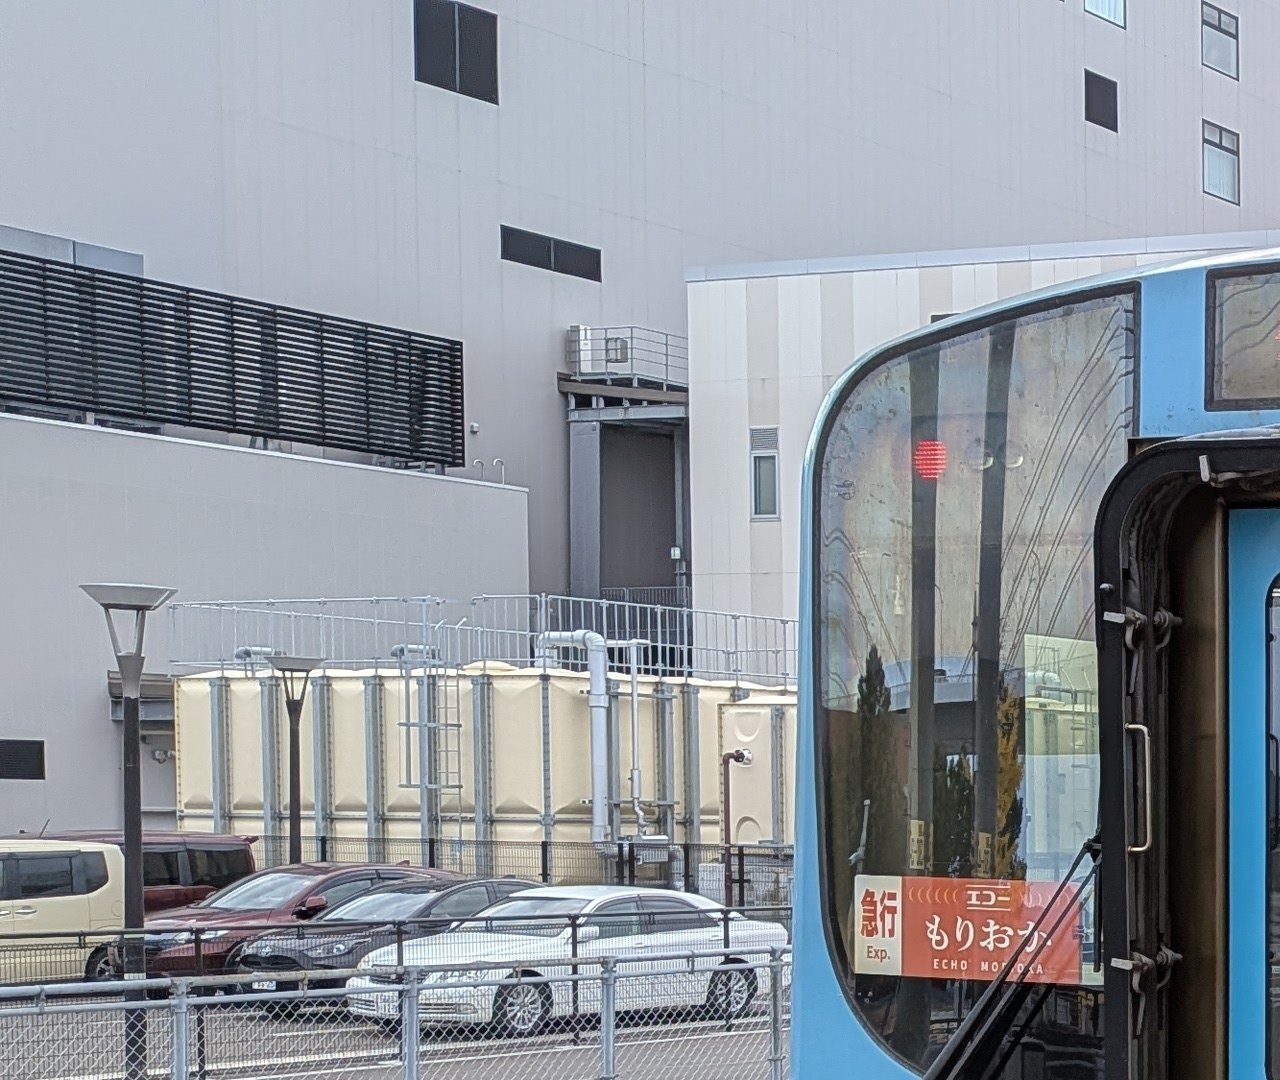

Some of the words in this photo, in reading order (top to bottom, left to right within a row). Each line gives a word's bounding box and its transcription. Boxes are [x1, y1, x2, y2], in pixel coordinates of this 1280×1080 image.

[966, 890, 1011, 905] エコー
[861, 888, 898, 939] 急行
[925, 914, 1052, 953] もりおか
[866, 945, 891, 963] Exp.
[933, 958, 968, 970] ECHO
